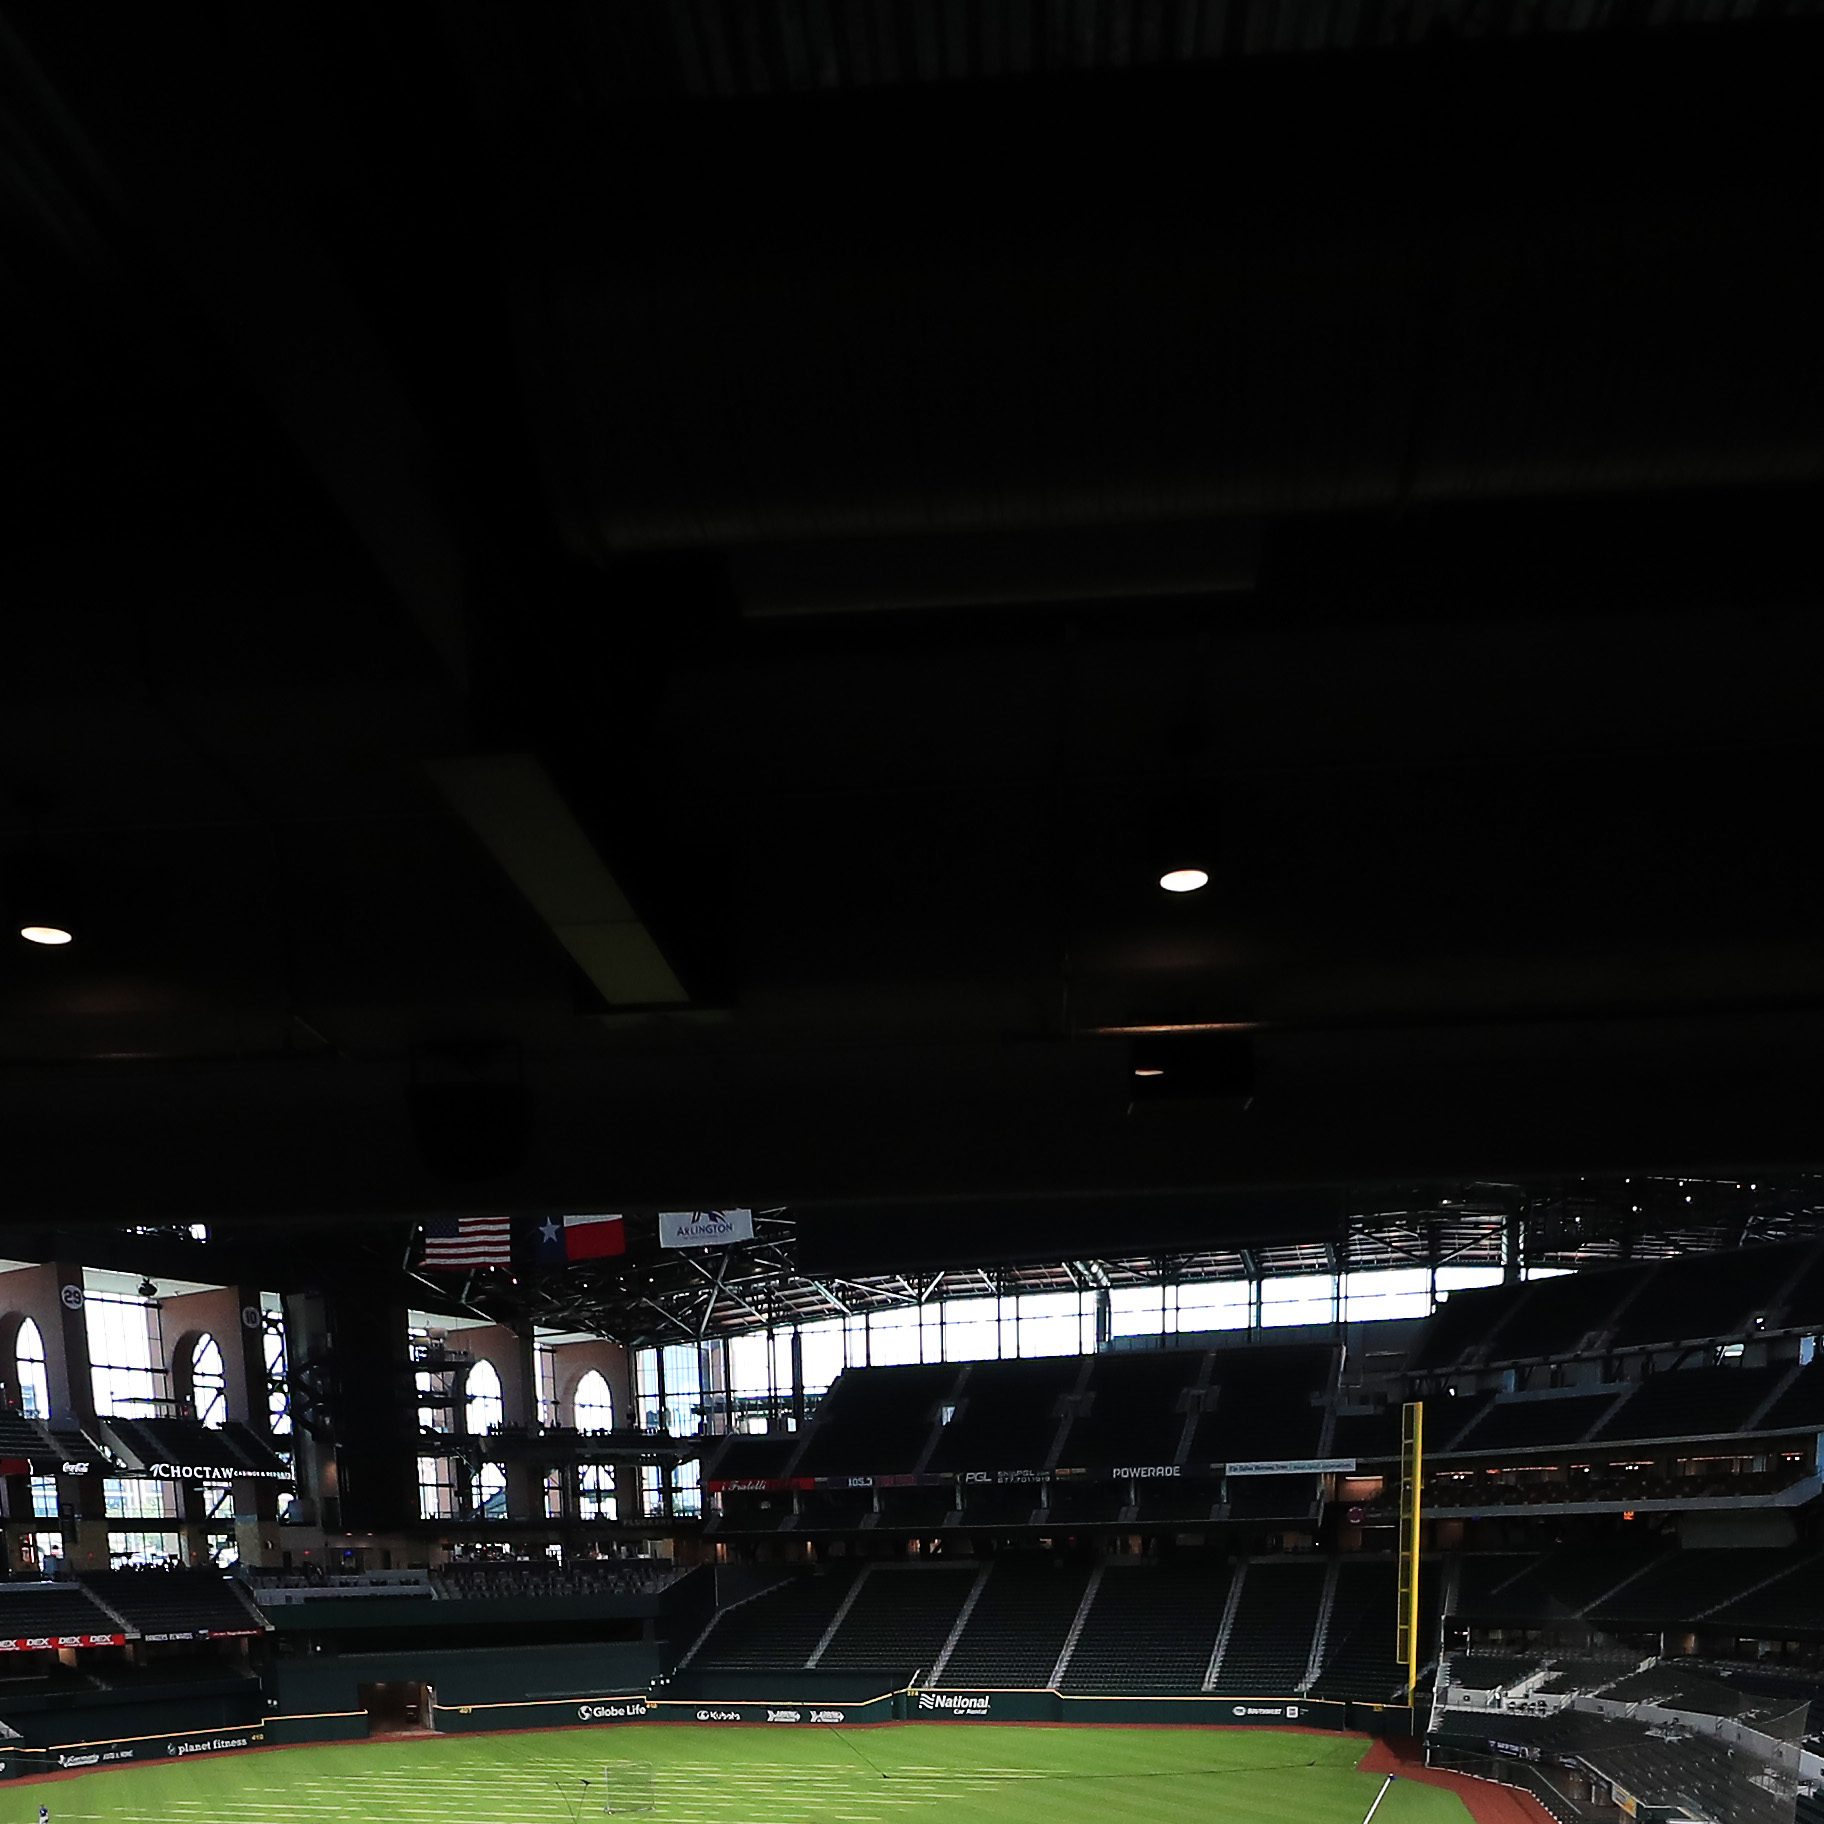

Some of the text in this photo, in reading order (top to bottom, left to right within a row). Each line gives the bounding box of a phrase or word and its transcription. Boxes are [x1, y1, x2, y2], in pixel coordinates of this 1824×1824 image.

[677, 1223, 733, 1236] ARLINGTON
[64, 1290, 81, 1304] 29
[158, 1463, 234, 1479] CHOCTAW
[965, 1471, 992, 1483] PGL
[1113, 1466, 1181, 1478] POWERADE
[593, 1704, 647, 1717] Globe Life
[177, 1737, 248, 1756] planet fitness
